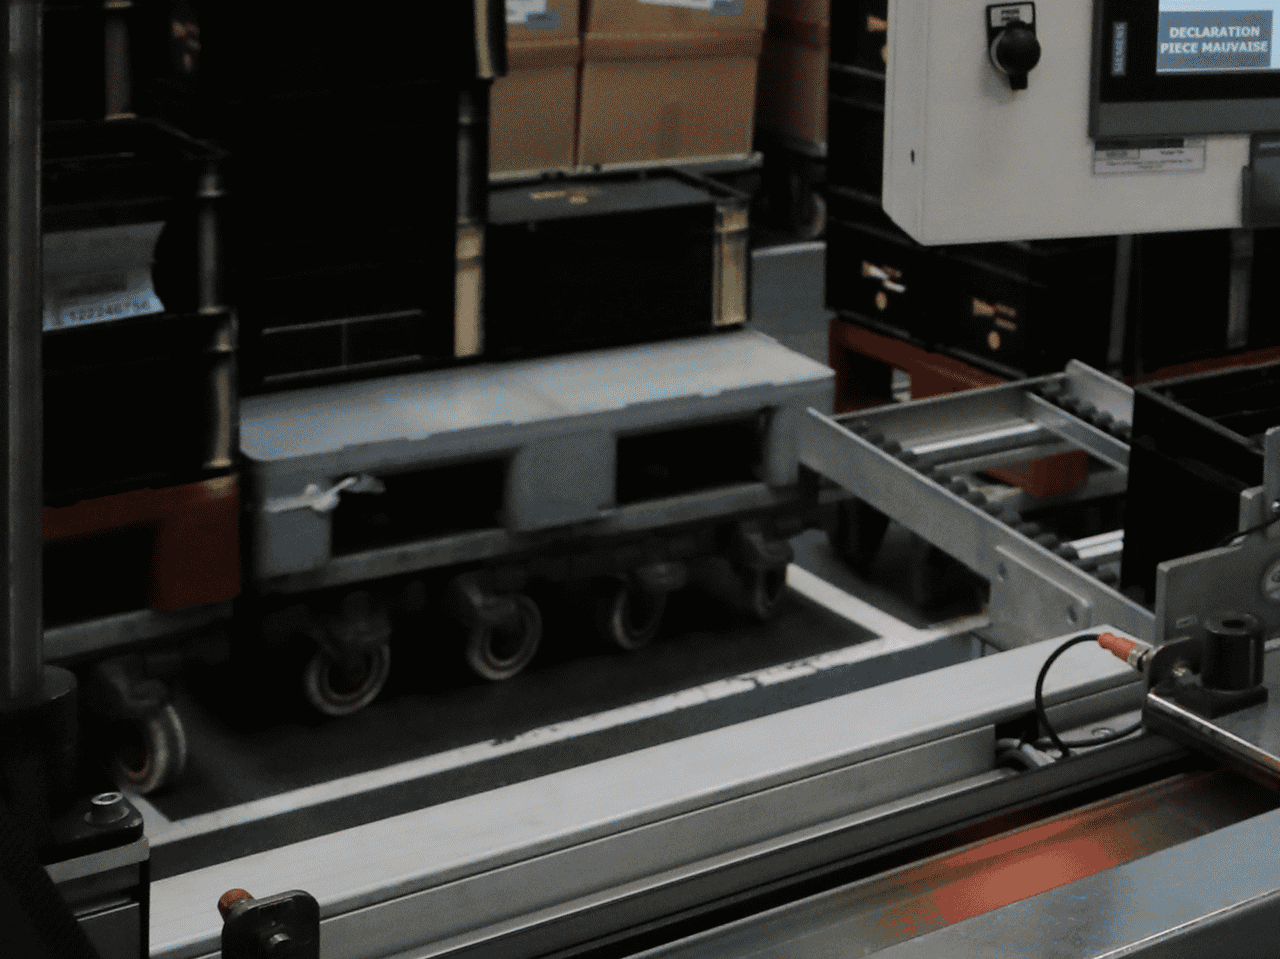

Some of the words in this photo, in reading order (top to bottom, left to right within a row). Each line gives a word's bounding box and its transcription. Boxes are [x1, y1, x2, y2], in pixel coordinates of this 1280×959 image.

[1169, 25, 1261, 39] DECLARATION
[1160, 41, 1199, 53] PIECE
[1202, 40, 1268, 54] MAUVAISE
